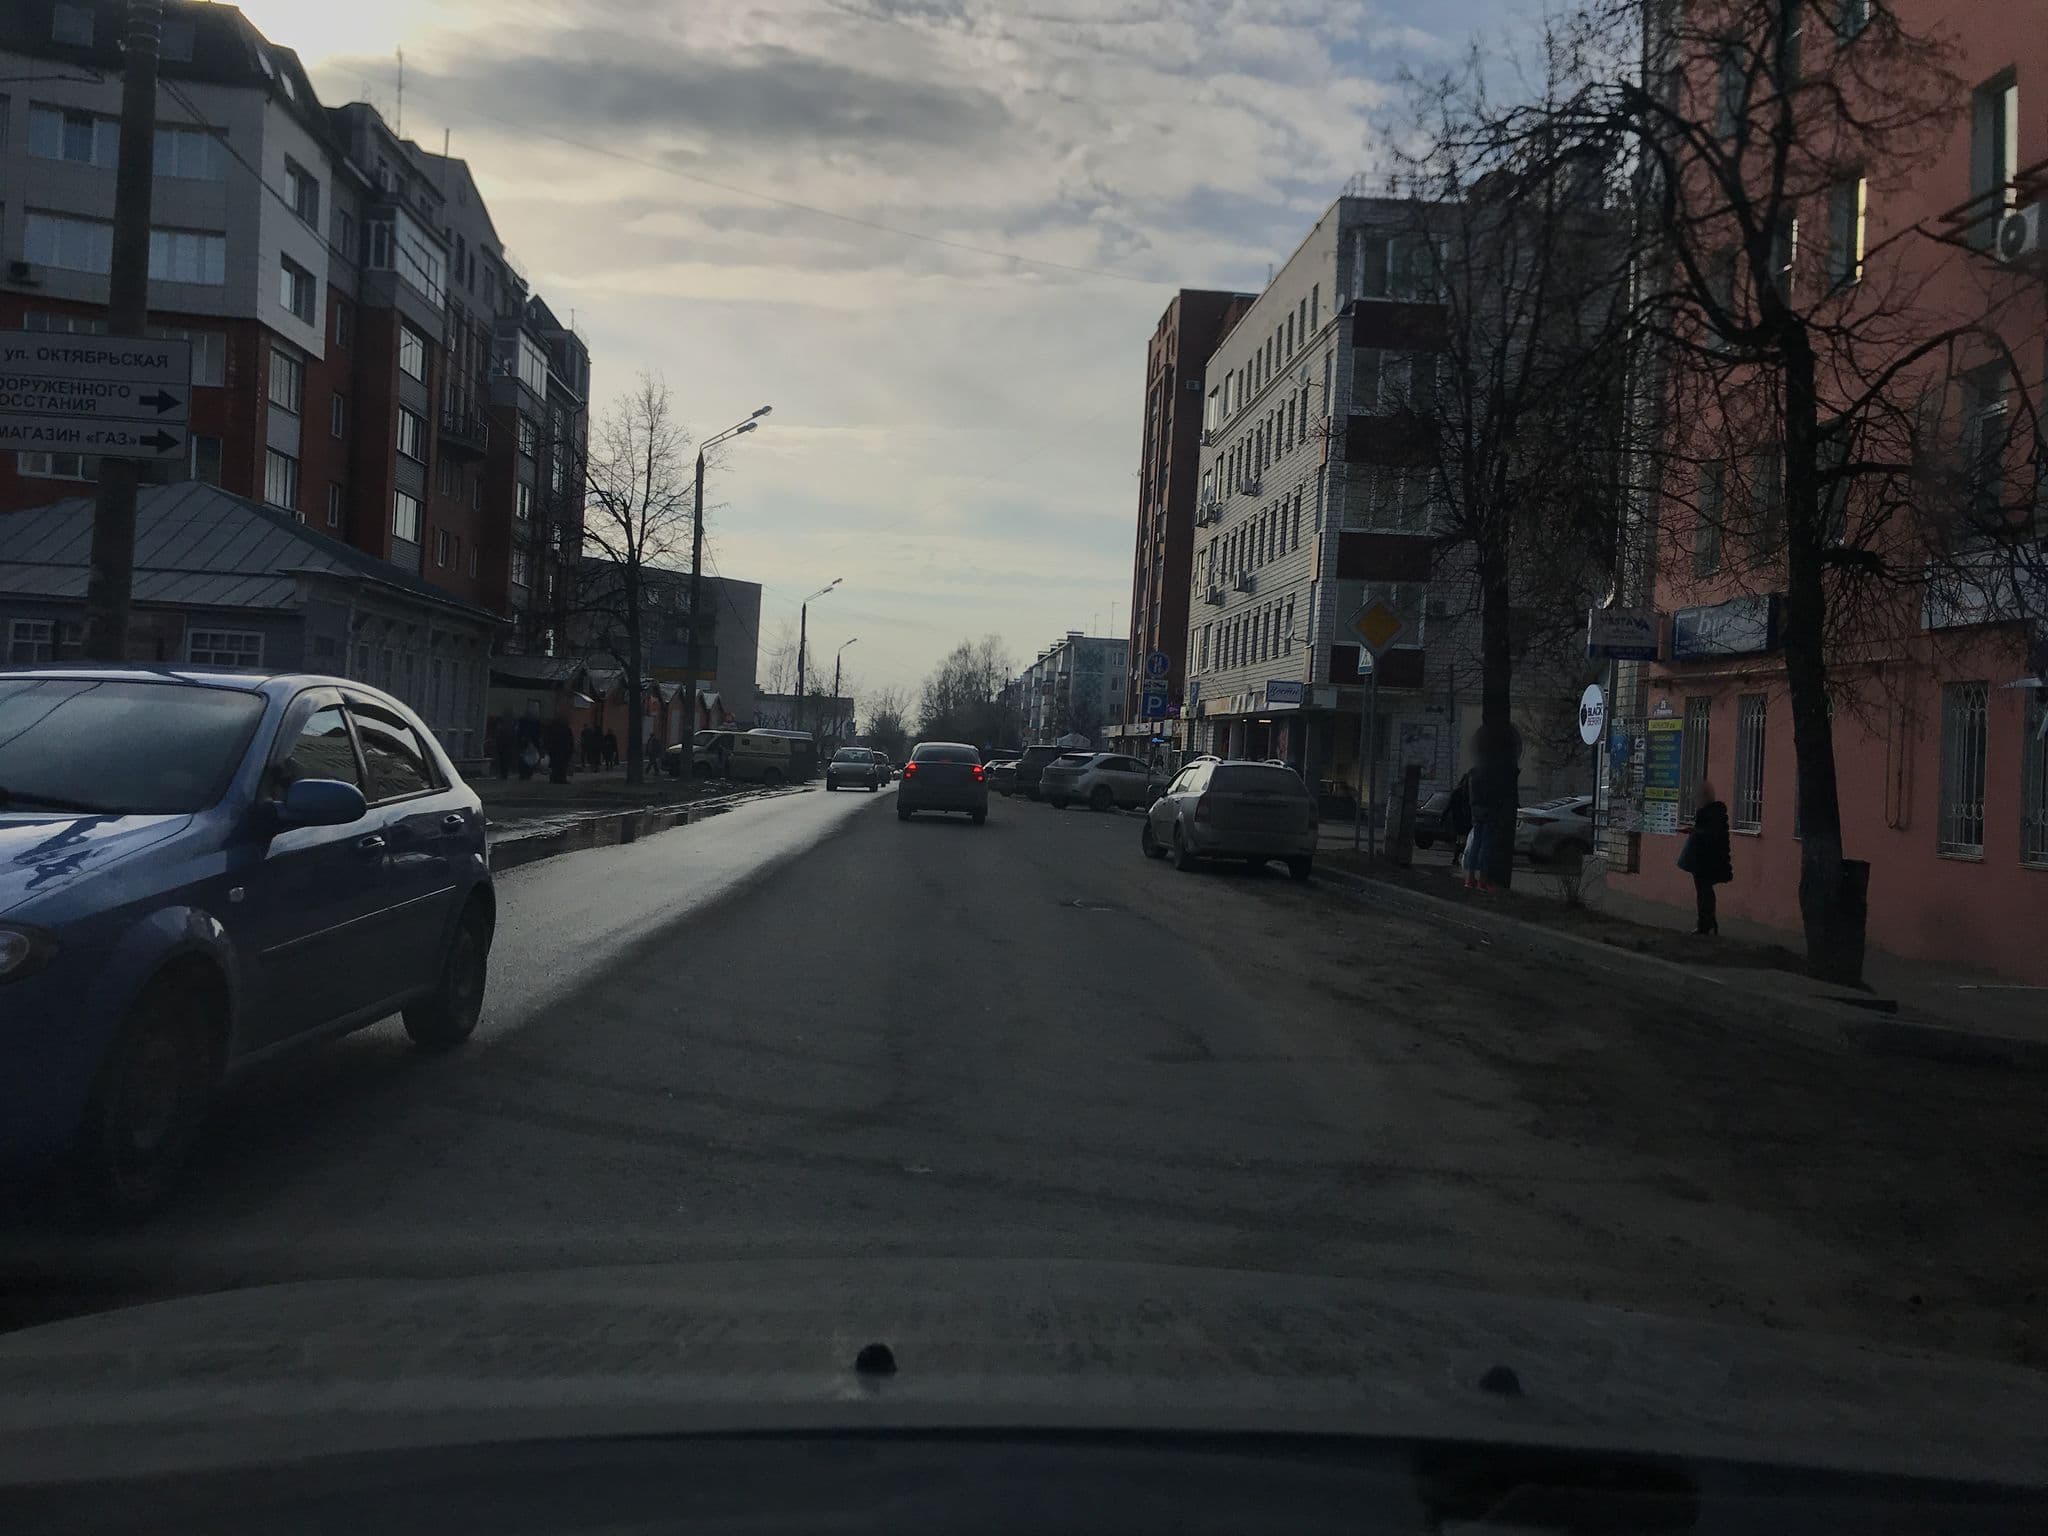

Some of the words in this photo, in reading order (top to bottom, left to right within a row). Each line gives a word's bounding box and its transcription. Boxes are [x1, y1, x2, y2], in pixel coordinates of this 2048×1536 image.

[4, 348, 29, 361] ул.
[37, 347, 169, 368] ОКТЯБРЬСКАЯ
[86, 431, 137, 445] «ГАЗ»
